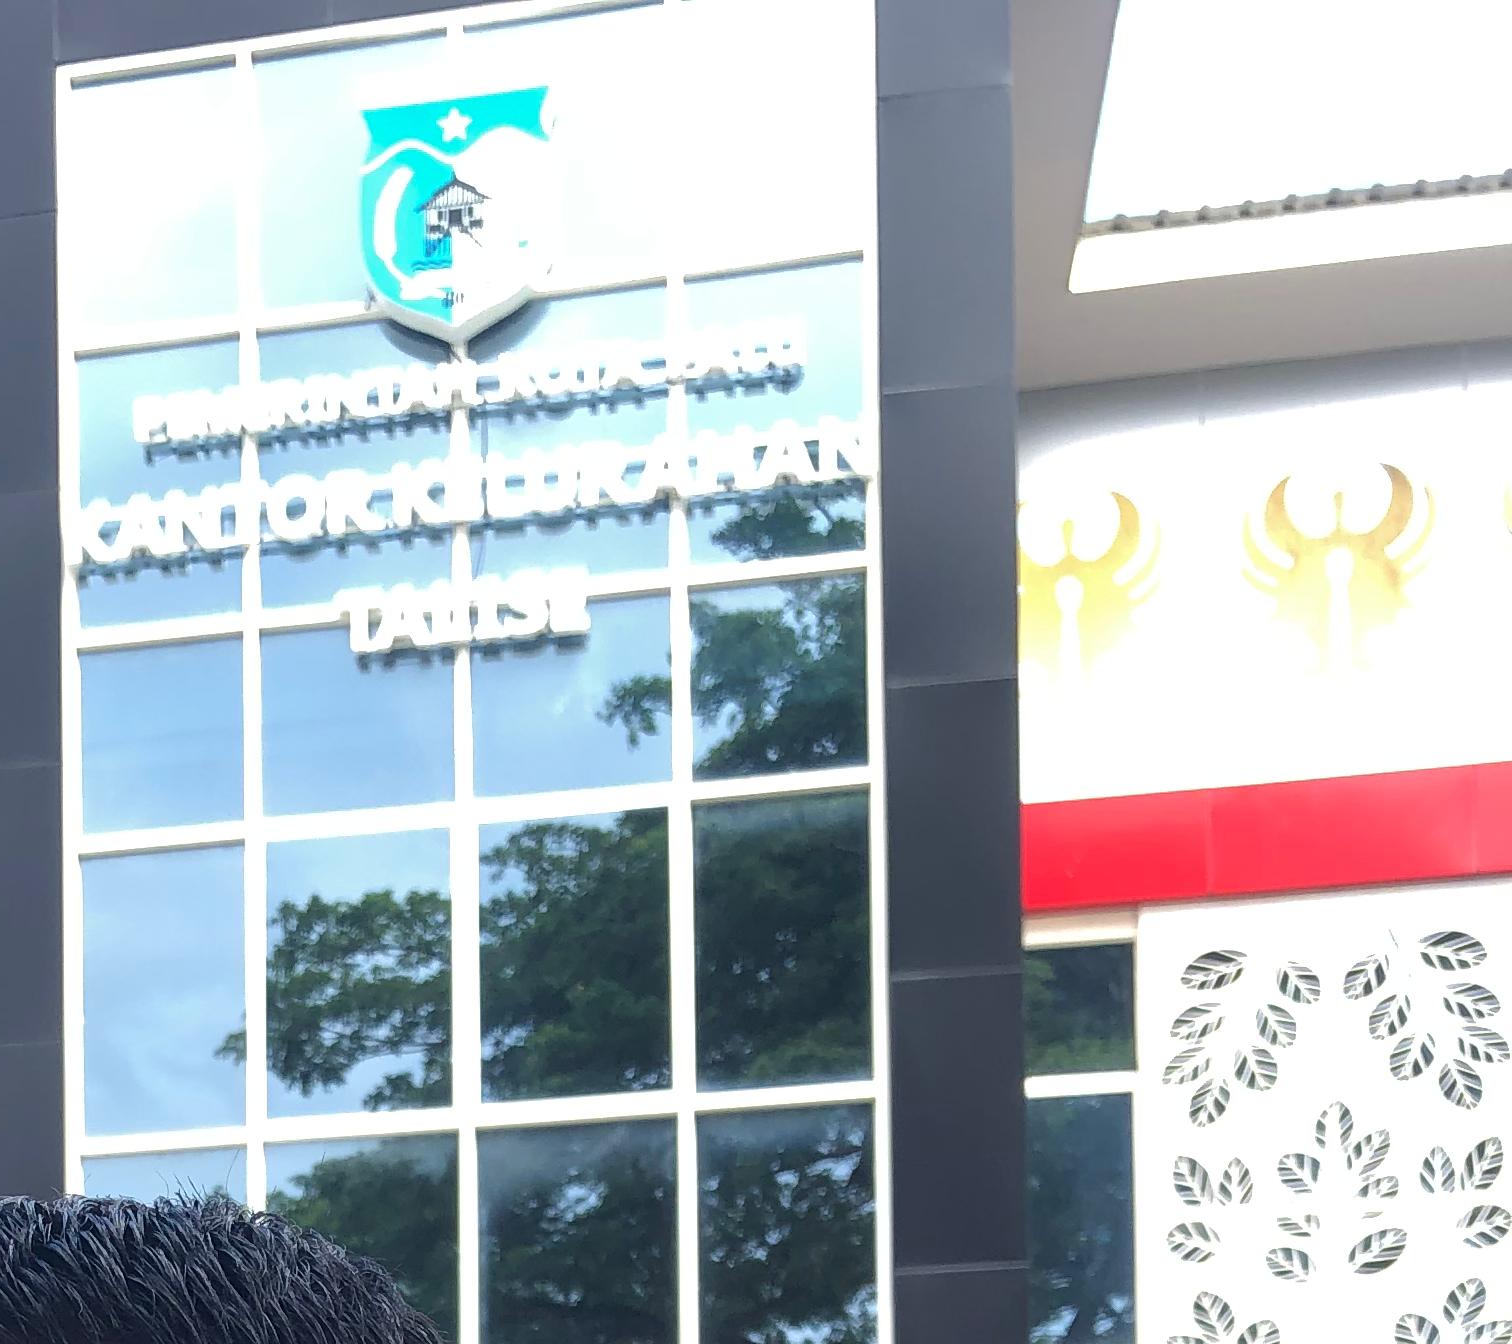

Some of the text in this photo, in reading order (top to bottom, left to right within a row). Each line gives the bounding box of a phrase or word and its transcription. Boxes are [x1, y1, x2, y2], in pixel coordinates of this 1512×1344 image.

[64, 412, 873, 566] KANTOR KELURAHAN
[332, 566, 591, 652] TALISE
